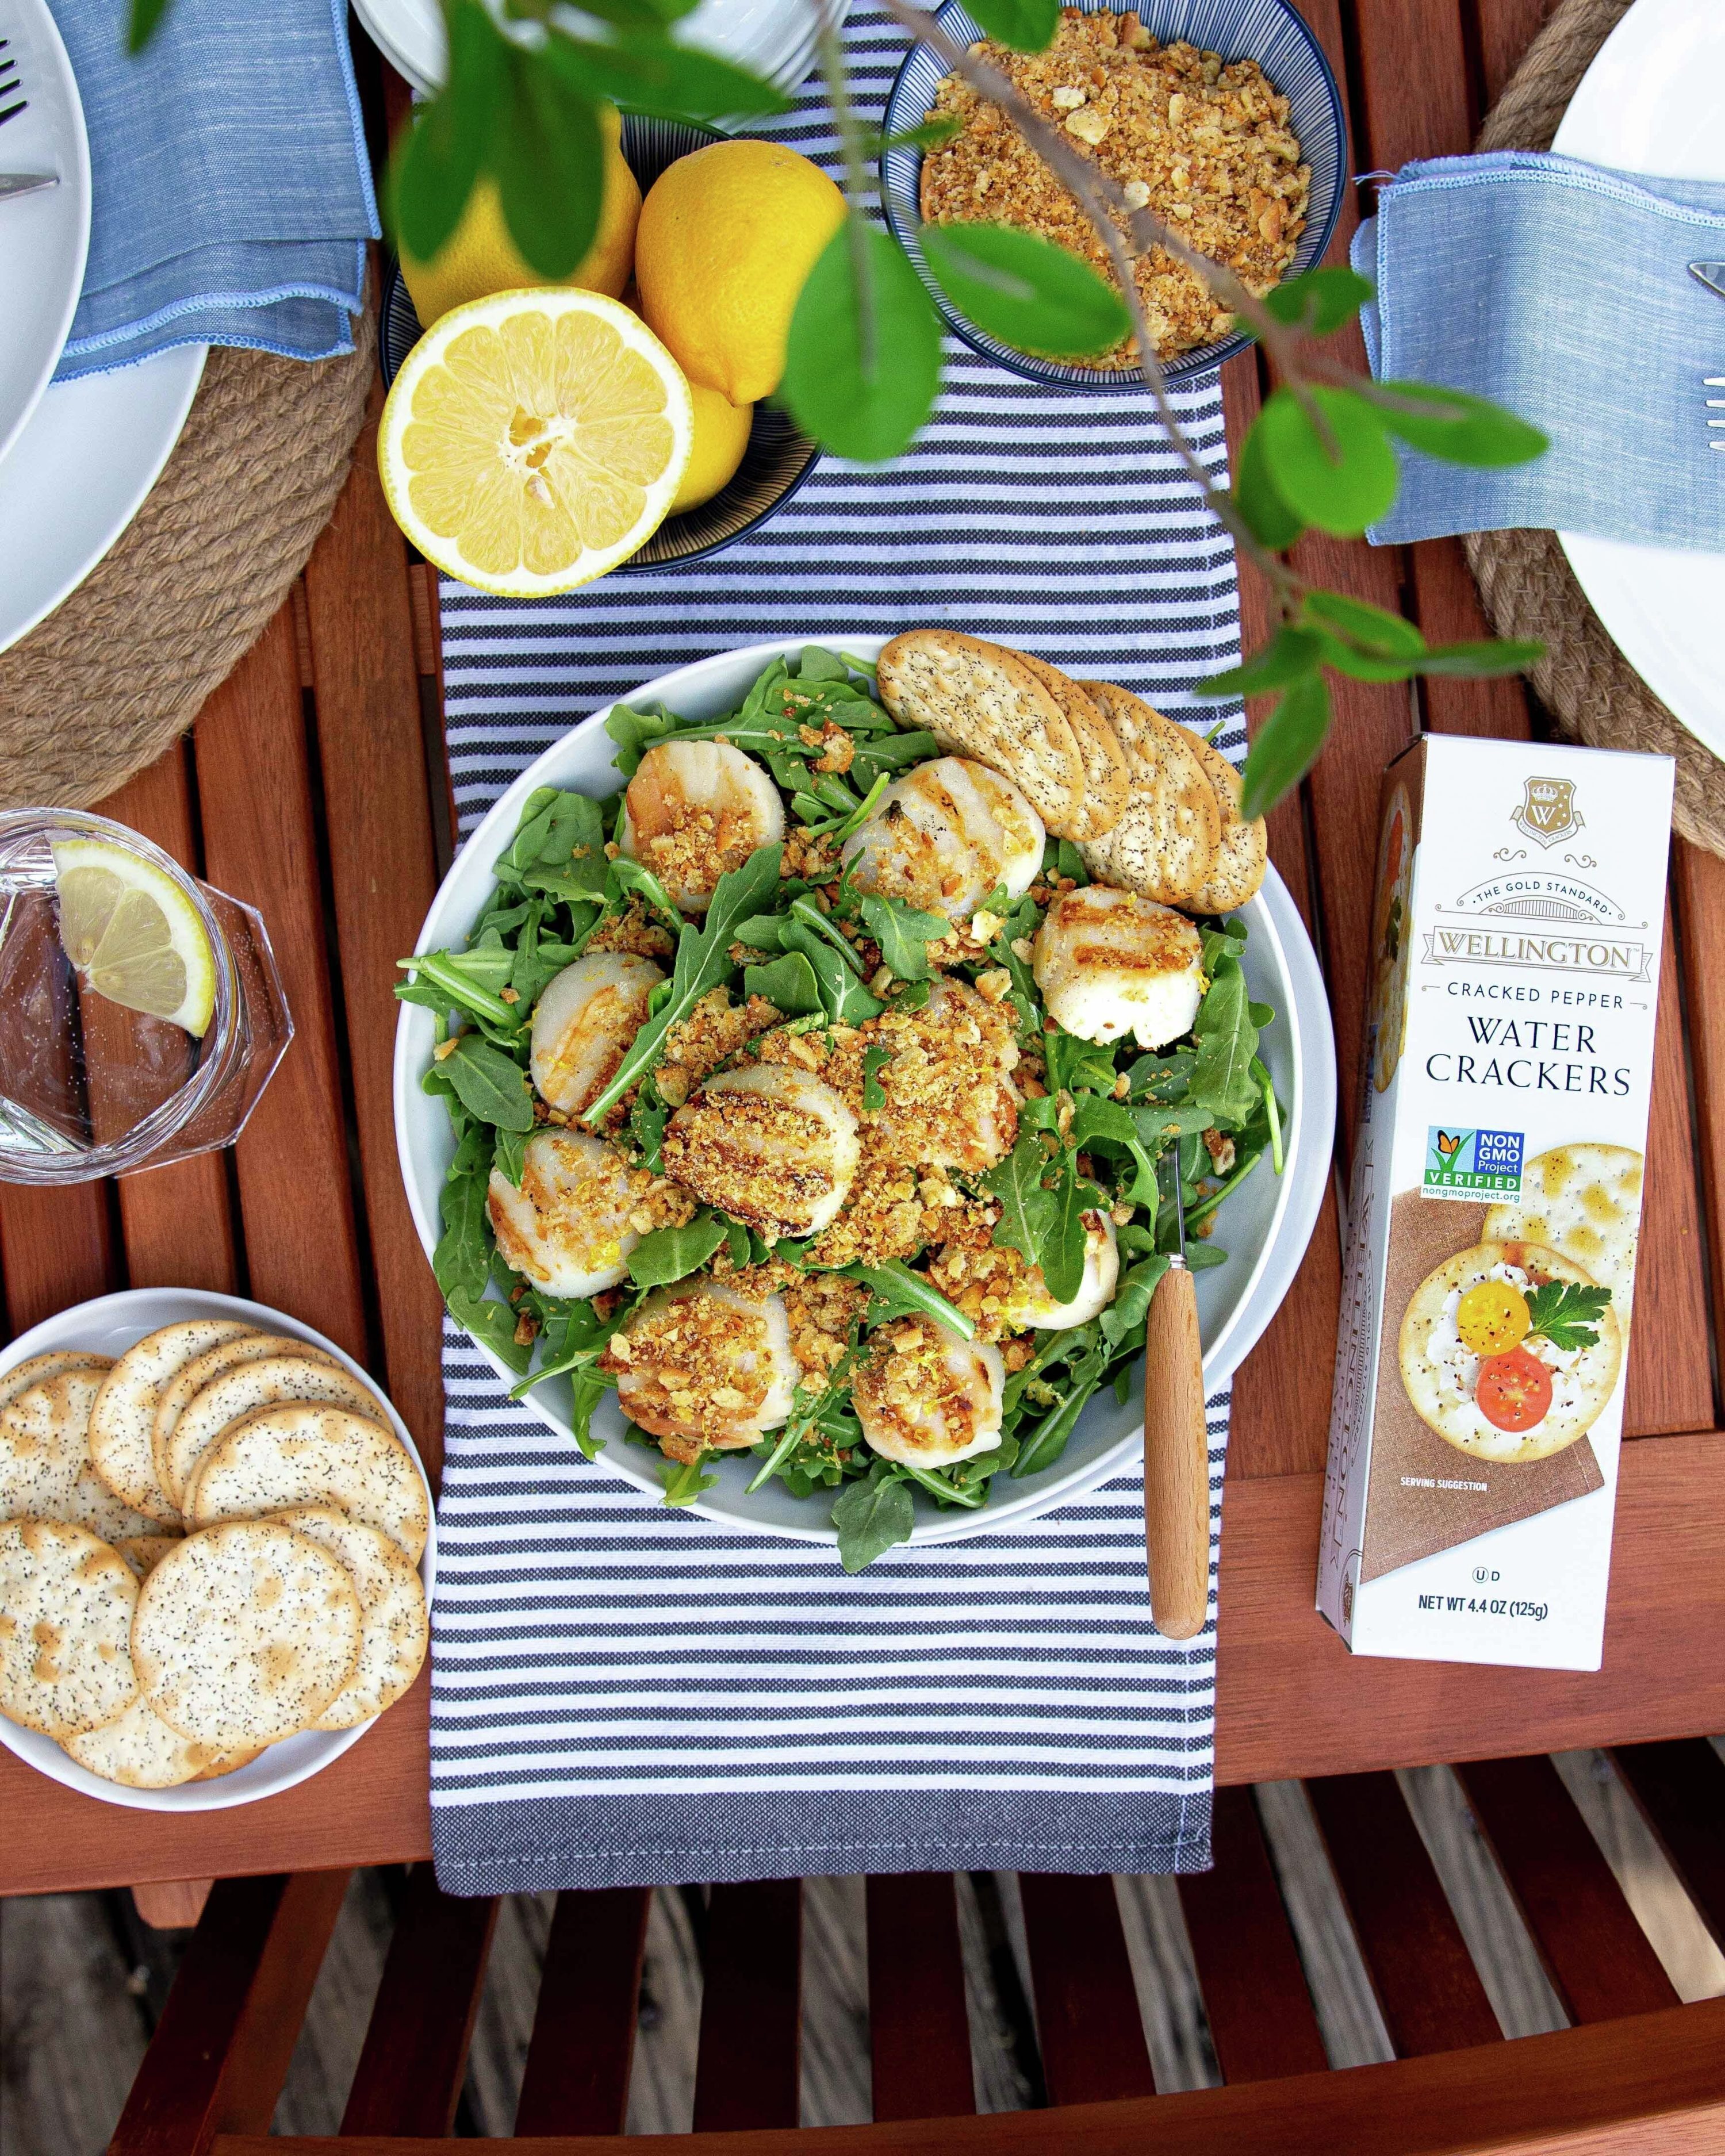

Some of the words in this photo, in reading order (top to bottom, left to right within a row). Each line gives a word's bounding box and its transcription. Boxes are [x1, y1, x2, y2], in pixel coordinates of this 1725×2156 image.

[1477, 887, 1500, 901] THE
[1506, 881, 1540, 891] GOLD
[1547, 883, 1608, 914] STANDARD
[1439, 931, 1632, 968] WELLINGTON
[1447, 982, 1540, 1002] CRACKED
[1551, 990, 1622, 1009] PEPPER
[1467, 1016, 1596, 1053] WATER
[1426, 1053, 1630, 1096] CRACKERS
[1481, 1133, 1520, 1149] NON
[1478, 1147, 1520, 1163] GMO
[1478, 1160, 1518, 1175] Project
[1429, 1171, 1517, 1190] VERIFIED
[1423, 1187, 1520, 1203] nongmoproject.org
[1337, 1194, 1370, 1518] WELLINGTON
[1400, 1476, 1436, 1488] SERVING
[1437, 1479, 1488, 1492] SUGGESTION
[1419, 1595, 1444, 1610] NET
[1447, 1597, 1466, 1612] WT
[1467, 1598, 1487, 1613] 4.4
[1490, 1599, 1507, 1614] OZ
[1509, 1601, 1548, 1621] (125g)
